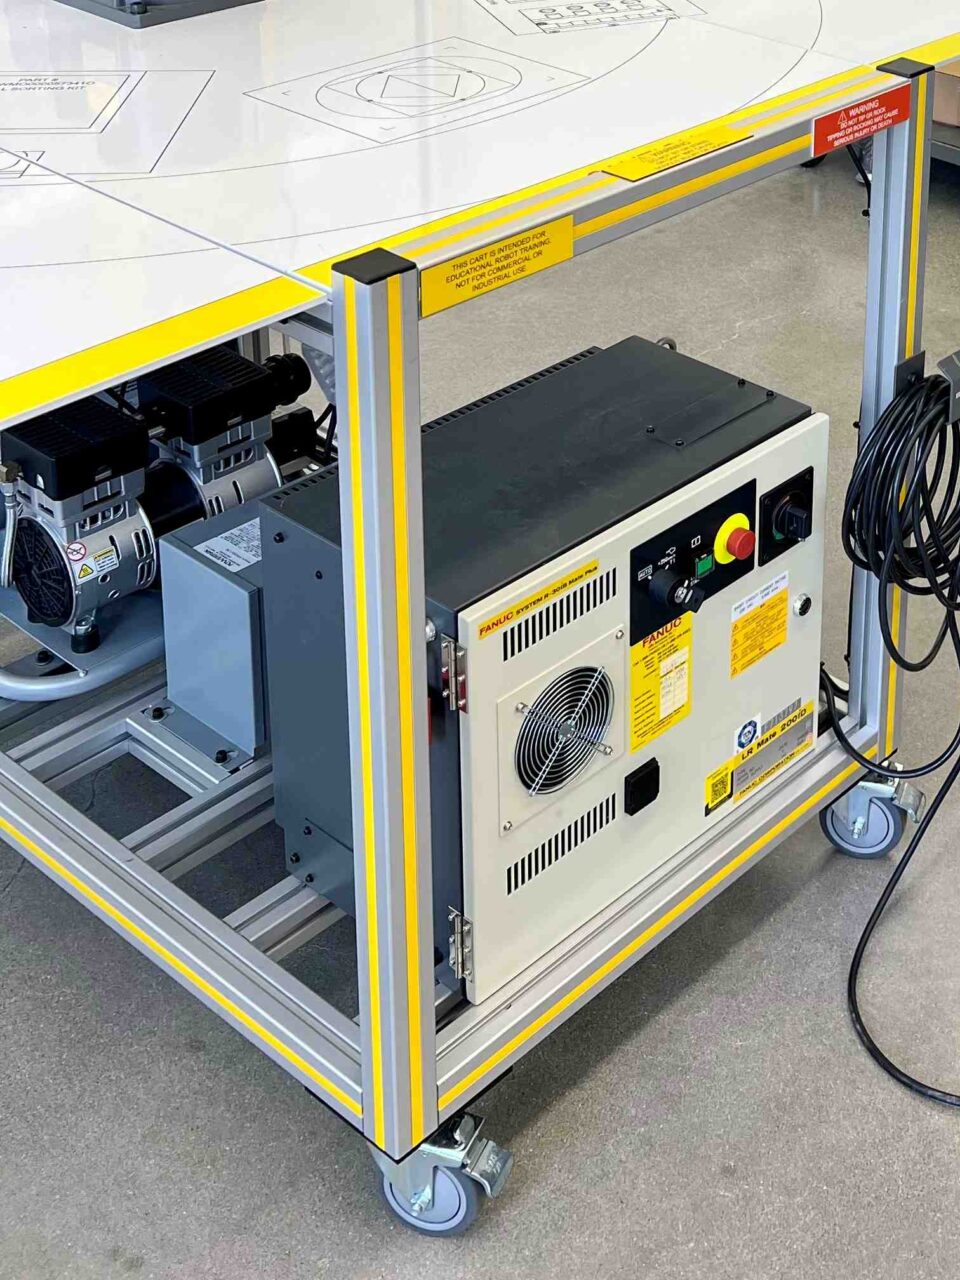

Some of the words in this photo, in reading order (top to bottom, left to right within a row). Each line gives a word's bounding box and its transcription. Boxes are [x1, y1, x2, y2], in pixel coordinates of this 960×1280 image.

[826, 130, 846, 142] TIPPING
[845, 126, 853, 135] OR
[853, 119, 874, 132] ROCKING
[873, 115, 884, 123] MAY
[883, 108, 899, 119] CAUSE
[840, 120, 848, 129] DO
[847, 117, 858, 126] NOT
[858, 114, 866, 122] TIP
[865, 111, 873, 119] OR
[873, 106, 887, 116] ROCK
[848, 99, 880, 117] WARNING
[833, 134, 854, 147] SERIOUS
[854, 128, 870, 138] INJURY
[445, 261, 494, 284] EDUCATIONAL
[494, 250, 519, 267] ROBOT
[452, 260, 469, 272] THIS
[469, 252, 488, 266] CART
[489, 249, 497, 258] IS
[497, 236, 532, 256] INTENDED
[531, 230, 547, 243] FOR
[455, 278, 470, 289] NOT
[471, 272, 487, 285] FOR
[487, 255, 532, 278] COMMERCIAL
[532, 250, 543, 259] OR
[471, 272, 512, 292] INDUSTRIAL
[479, 611, 514, 636] FANUC
[515, 596, 543, 616] SYSTEM
[544, 582, 568, 600] R-30iB
[568, 573, 584, 586] Mate
[584, 565, 598, 576] Plus
[642, 616, 682, 648] FANUC
[741, 747, 754, 761] LR
[756, 730, 777, 750] Mate
[780, 707, 807, 732] 200iD
